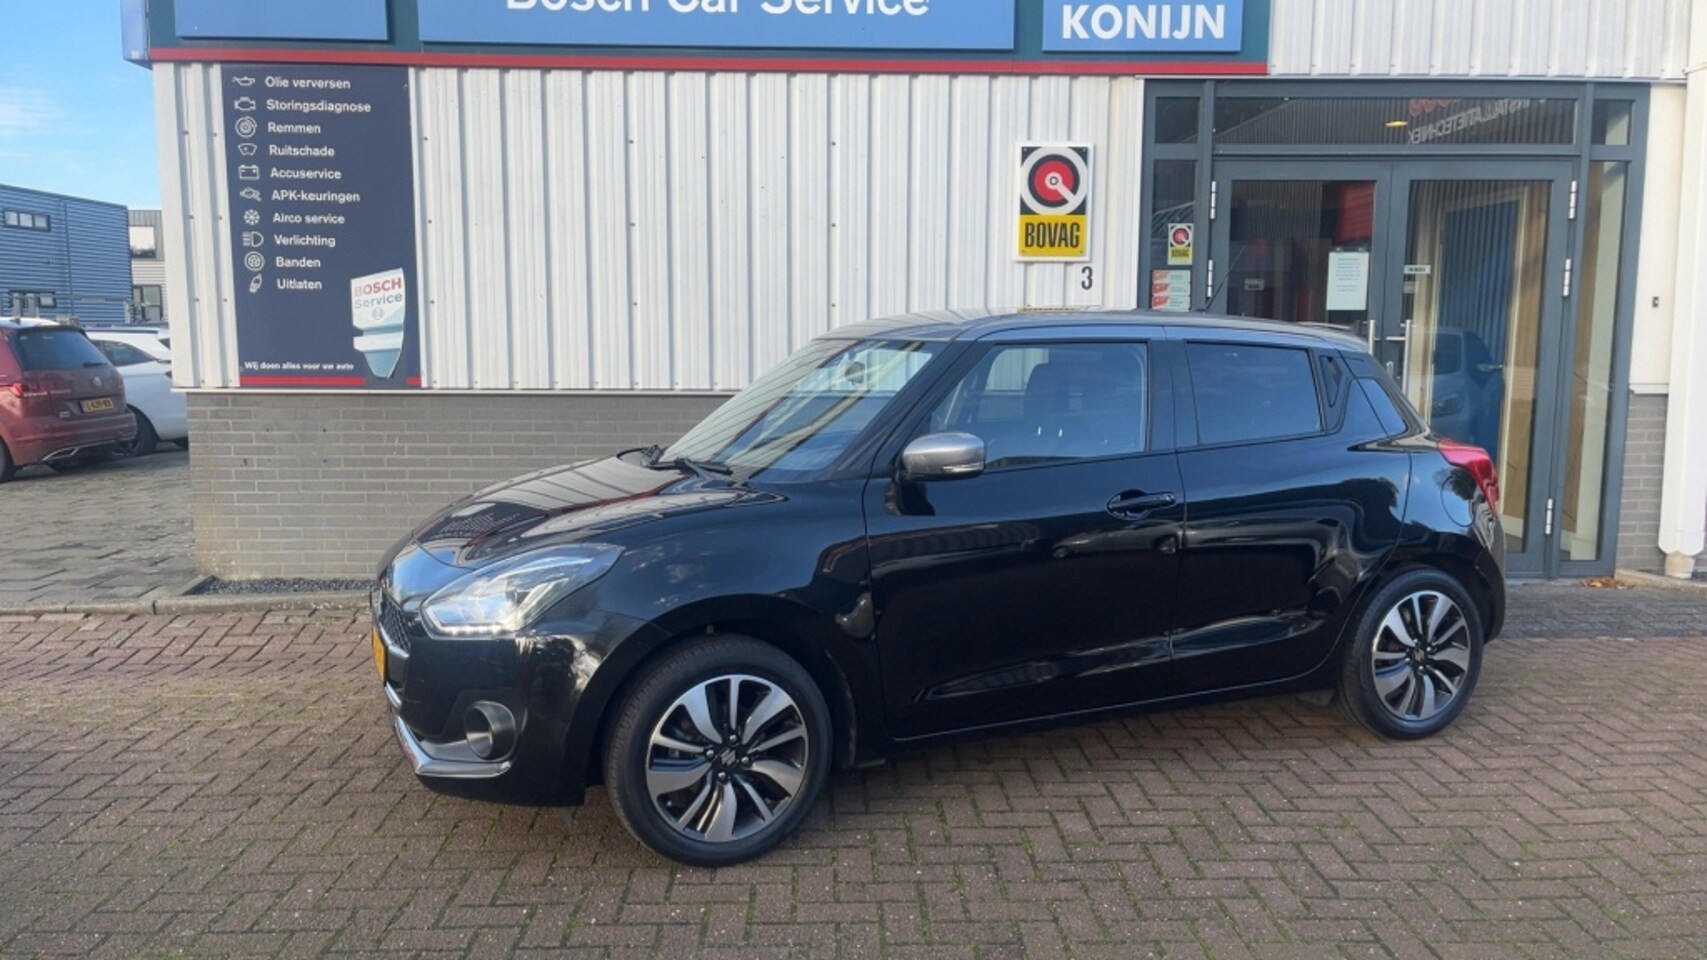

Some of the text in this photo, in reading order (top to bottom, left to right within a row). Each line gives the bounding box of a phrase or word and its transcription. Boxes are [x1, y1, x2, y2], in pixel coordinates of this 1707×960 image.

[1062, 4, 1225, 40] KONIJN
[264, 75, 351, 90] Olie verversen
[266, 98, 372, 114] Storingsdiagnose
[267, 121, 321, 134] Remmen
[268, 144, 335, 157] Ruitschade
[270, 167, 342, 180] Accuservice
[271, 189, 361, 204] APK-keuringen
[272, 212, 346, 225] Airco service
[273, 234, 336, 248] Verlichting
[1024, 221, 1080, 249] BOVAG
[275, 256, 321, 268] Banden
[276, 278, 323, 290] Uitlaten
[1080, 266, 1093, 290] 3
[354, 277, 402, 298] BOSCH
[354, 293, 403, 309] Service
[244, 361, 259, 371] Wij
[259, 361, 281, 370] doen
[281, 361, 301, 370] alles
[302, 363, 321, 371] voor
[336, 363, 355, 371] auto
